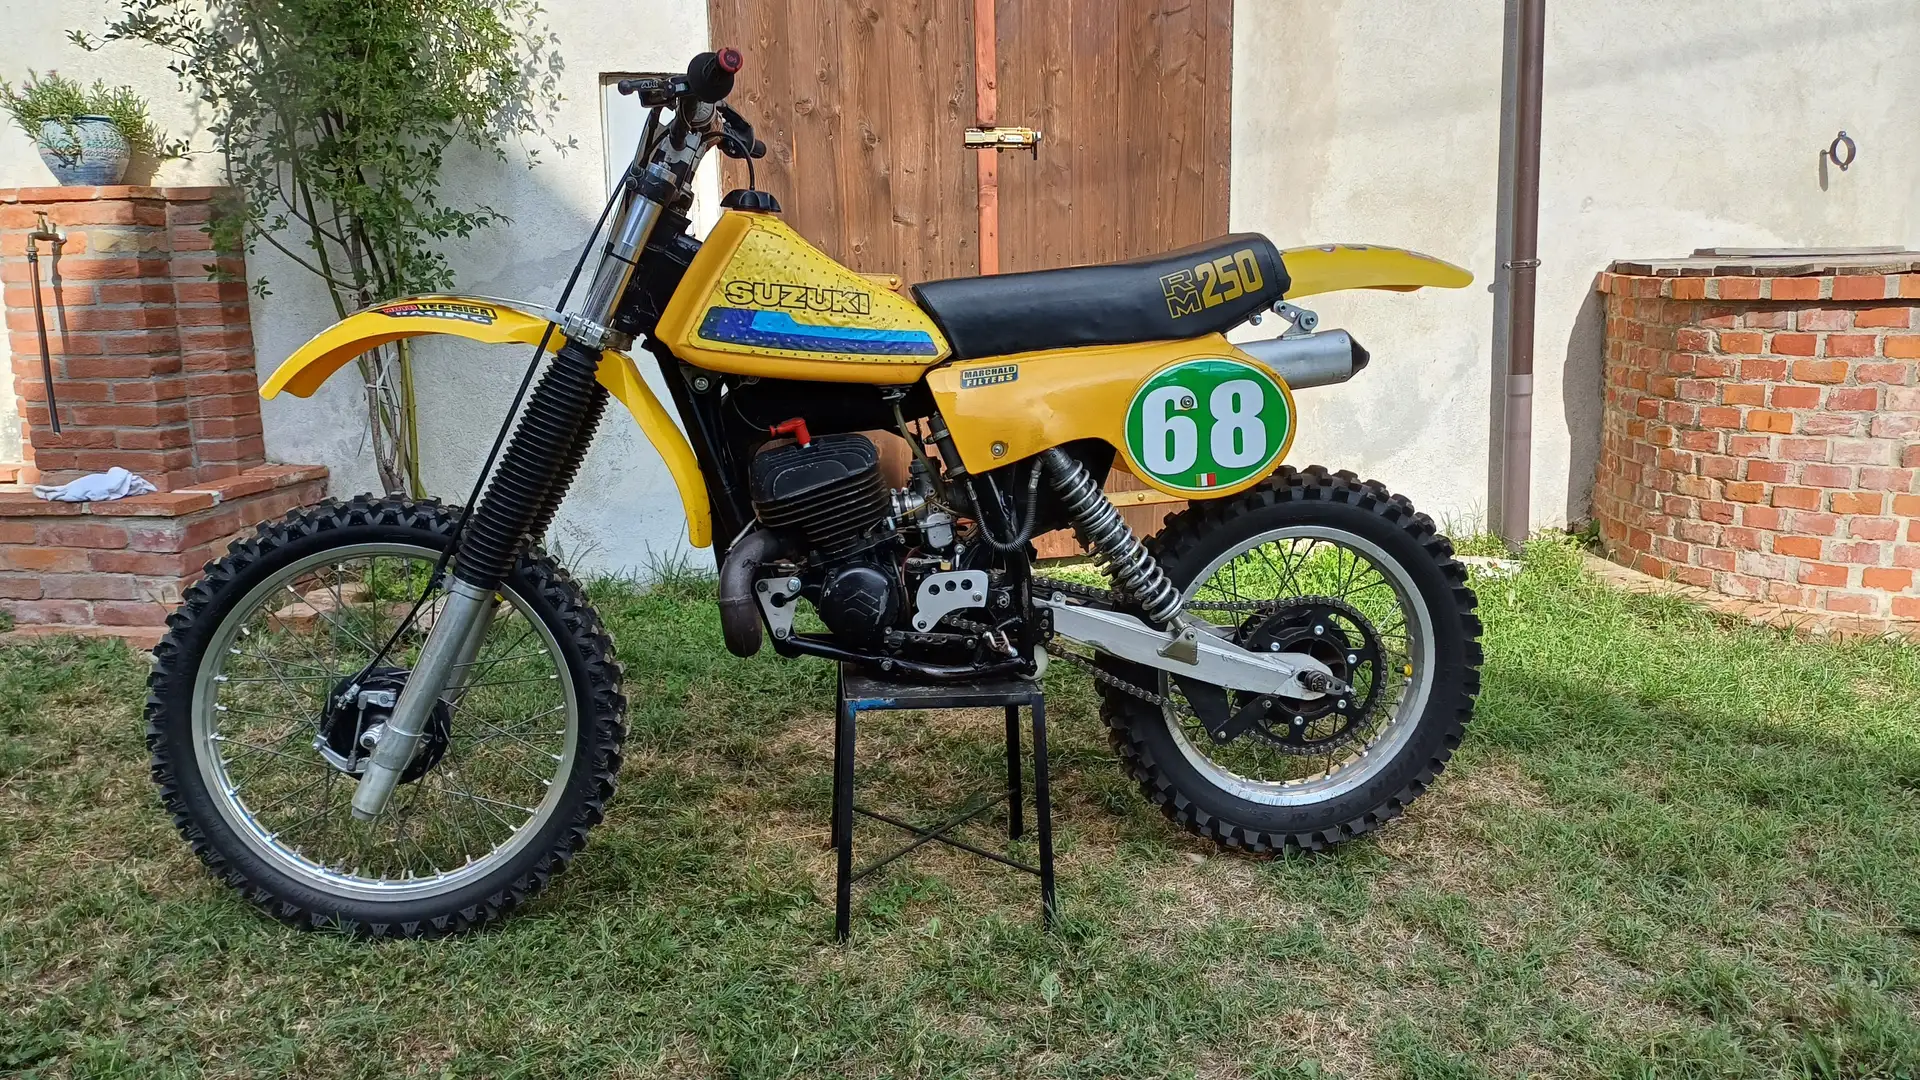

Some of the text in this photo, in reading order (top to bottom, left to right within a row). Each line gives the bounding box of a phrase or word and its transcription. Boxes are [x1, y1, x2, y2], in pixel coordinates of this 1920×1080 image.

[1194, 248, 1264, 309] 250
[419, 303, 490, 317] TECNICA
[725, 280, 870, 315] SUZUKI
[966, 374, 1013, 387] FILTERS
[1142, 379, 1267, 475] 68
